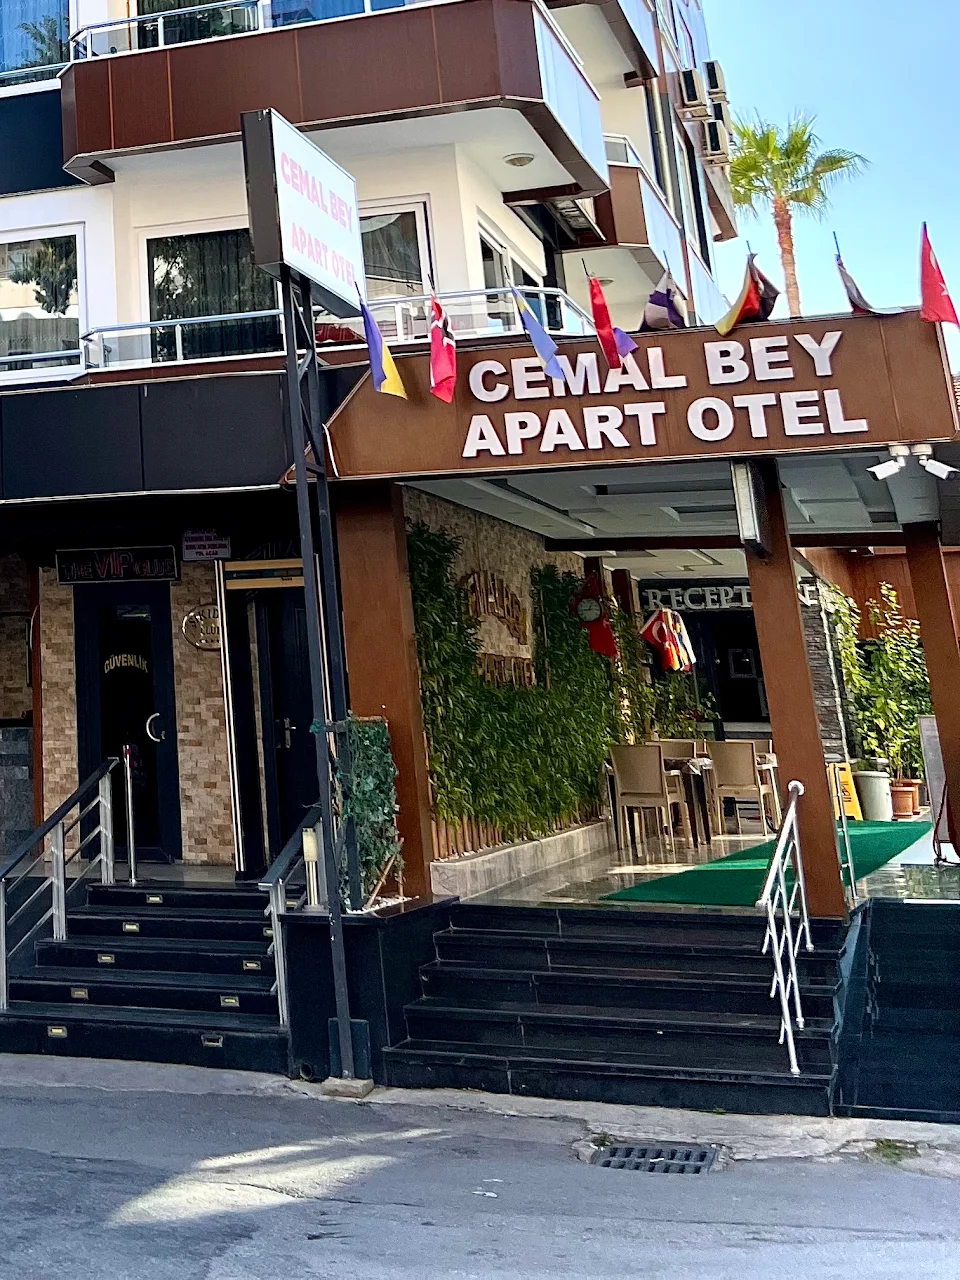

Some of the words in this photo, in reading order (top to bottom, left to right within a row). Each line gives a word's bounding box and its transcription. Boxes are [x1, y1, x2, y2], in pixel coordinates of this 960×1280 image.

[280, 152, 328, 215] CEMAL
[328, 189, 353, 234] BEY
[291, 222, 328, 269] APART
[332, 249, 355, 288] OTEL
[468, 346, 687, 403] CEMAL
[703, 331, 842, 386] BEY
[462, 400, 665, 458] APART
[686, 389, 868, 442] OTEL
[93, 551, 133, 578] VIP
